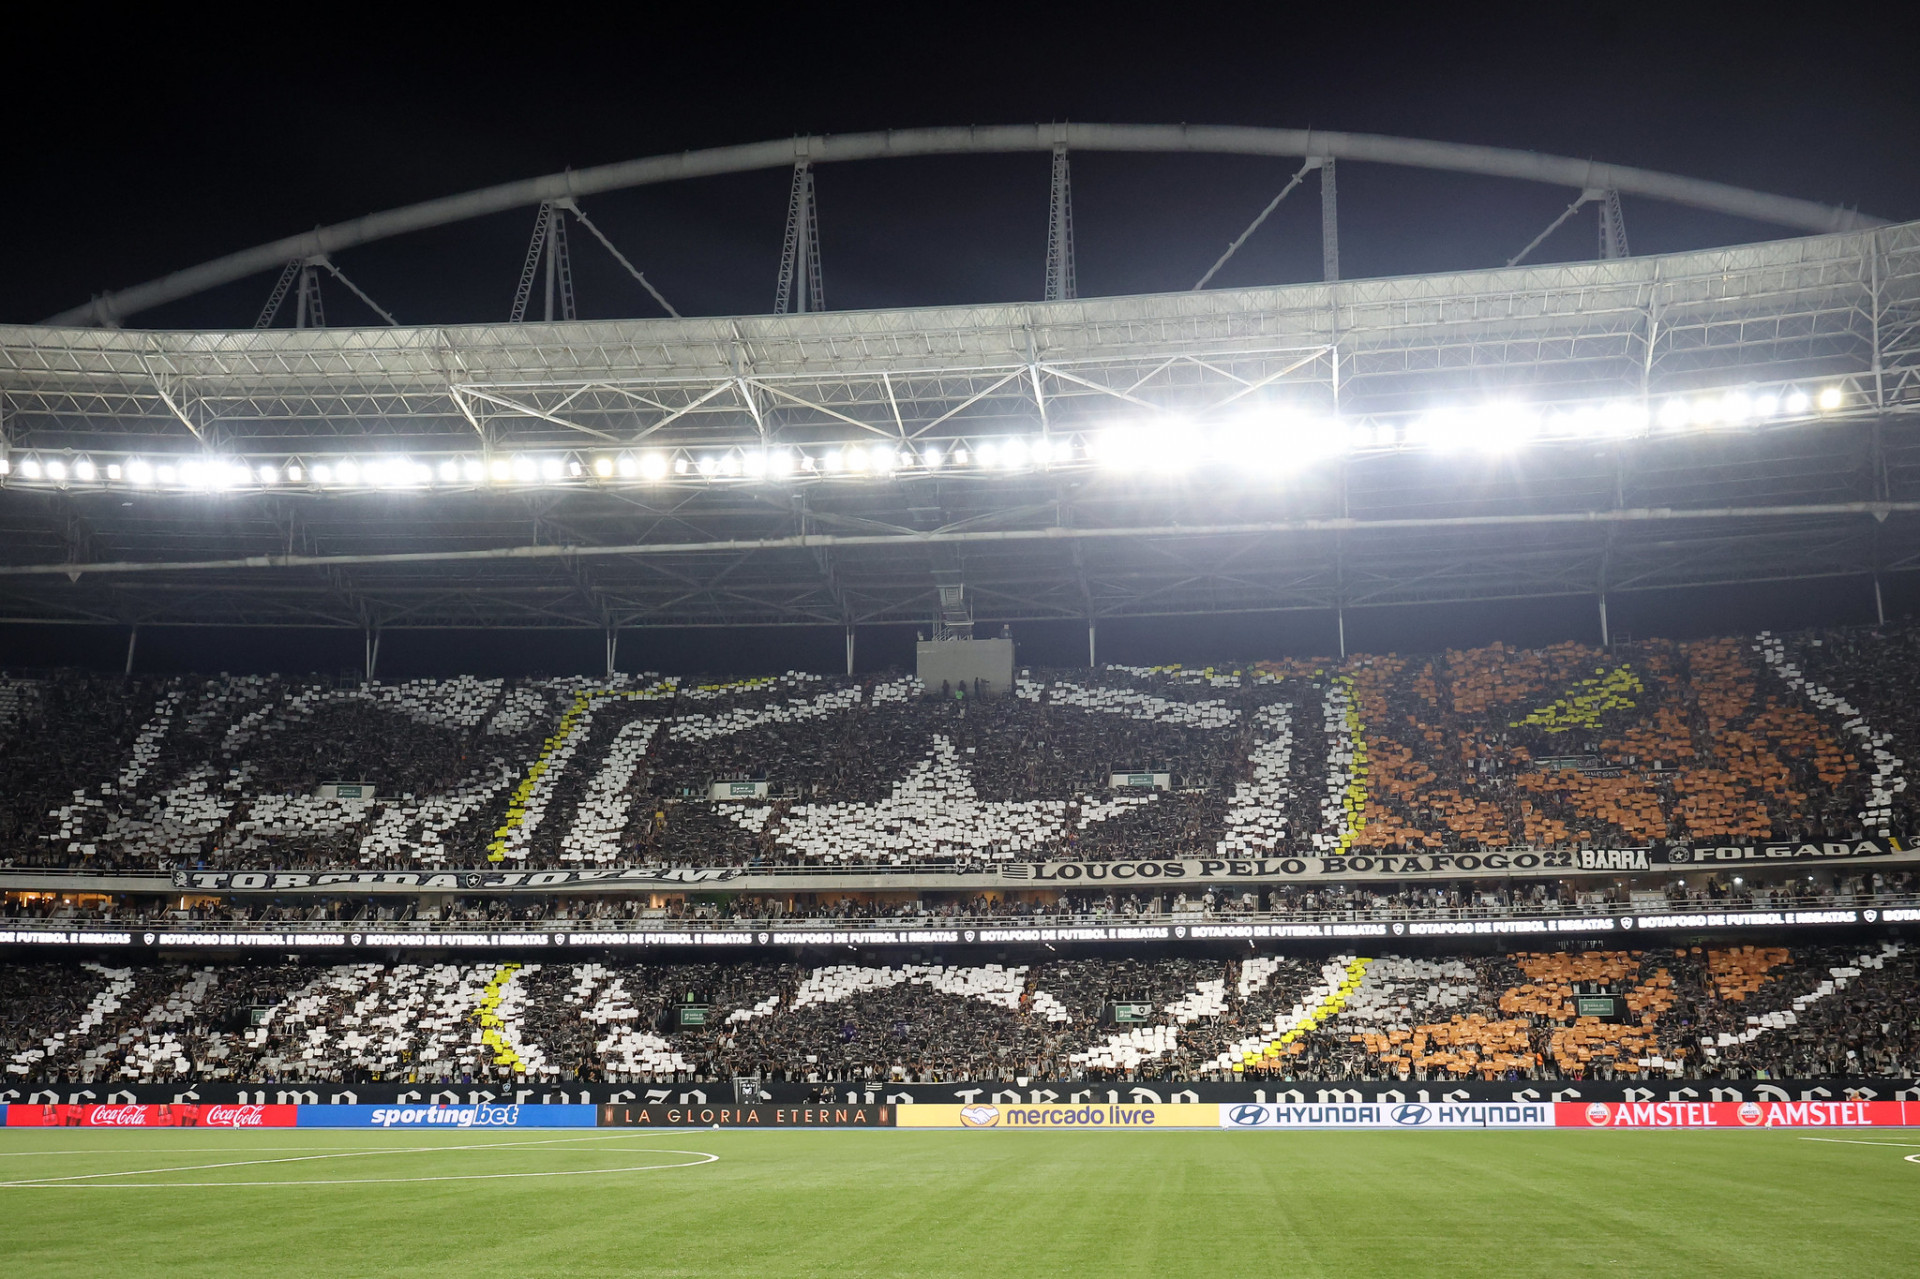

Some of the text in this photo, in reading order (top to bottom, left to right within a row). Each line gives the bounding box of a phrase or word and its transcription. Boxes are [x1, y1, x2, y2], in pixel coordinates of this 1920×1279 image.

[1694, 840, 1883, 861] FOLGADA
[1031, 861, 1186, 880] LOUCOS
[1199, 858, 1307, 876] PELO
[1320, 853, 1540, 873] BOTAFOGO
[1581, 850, 1649, 870] BARRA
[1408, 921, 1475, 935] BOTAFOGO
[1474, 921, 1492, 934] DE
[1492, 920, 1548, 934] FUTEBOL
[1548, 919, 1557, 932] E
[1637, 915, 1707, 929] BOTAFOGO
[1707, 914, 1726, 927] DE
[1725, 912, 1786, 926] FUTEBOL
[1785, 912, 1795, 924] E
[16, 931, 70, 944] FUTEBOL
[70, 932, 78, 944] E
[158, 933, 220, 946] BOTAFOGO
[220, 934, 237, 946] DE
[235, 934, 286, 946] FUTEBOL
[287, 934, 294, 946] E
[569, 933, 629, 945] BOTAFOGO
[628, 933, 645, 945] DE
[644, 933, 694, 945] FUTEBOL
[694, 933, 702, 945] E
[773, 932, 833, 945] BOTAFOGO
[832, 932, 849, 944] DE
[849, 931, 899, 944] FUTEBOL
[900, 931, 907, 943] E
[979, 929, 1041, 942] BOTAFOGO
[1040, 929, 1058, 941] DE
[1056, 928, 1108, 941] FUTEBOL
[1109, 927, 1116, 940] E
[1190, 926, 1253, 938] BOTAFOGO
[1252, 925, 1271, 938] DE
[1270, 924, 1324, 937] FUTEBOL
[1324, 924, 1332, 937] E
[365, 934, 426, 946] BOTAFOGO
[425, 934, 442, 946] DE
[441, 934, 491, 946] FUTEBOL
[491, 934, 499, 946] E
[90, 1104, 149, 1125] Coca-Cola
[206, 1104, 265, 1125] Coca-Cola
[371, 1104, 519, 1126] sportingbet
[625, 1108, 867, 1123] LA GLORIA ETERNA
[1007, 1106, 1155, 1125] mercado livre
[1276, 1106, 1381, 1123] HYUNDAI
[1438, 1106, 1545, 1122] HYUNDAI
[1613, 1103, 1718, 1126] AMSTEL
[1766, 1102, 1872, 1125] AMSTEL
